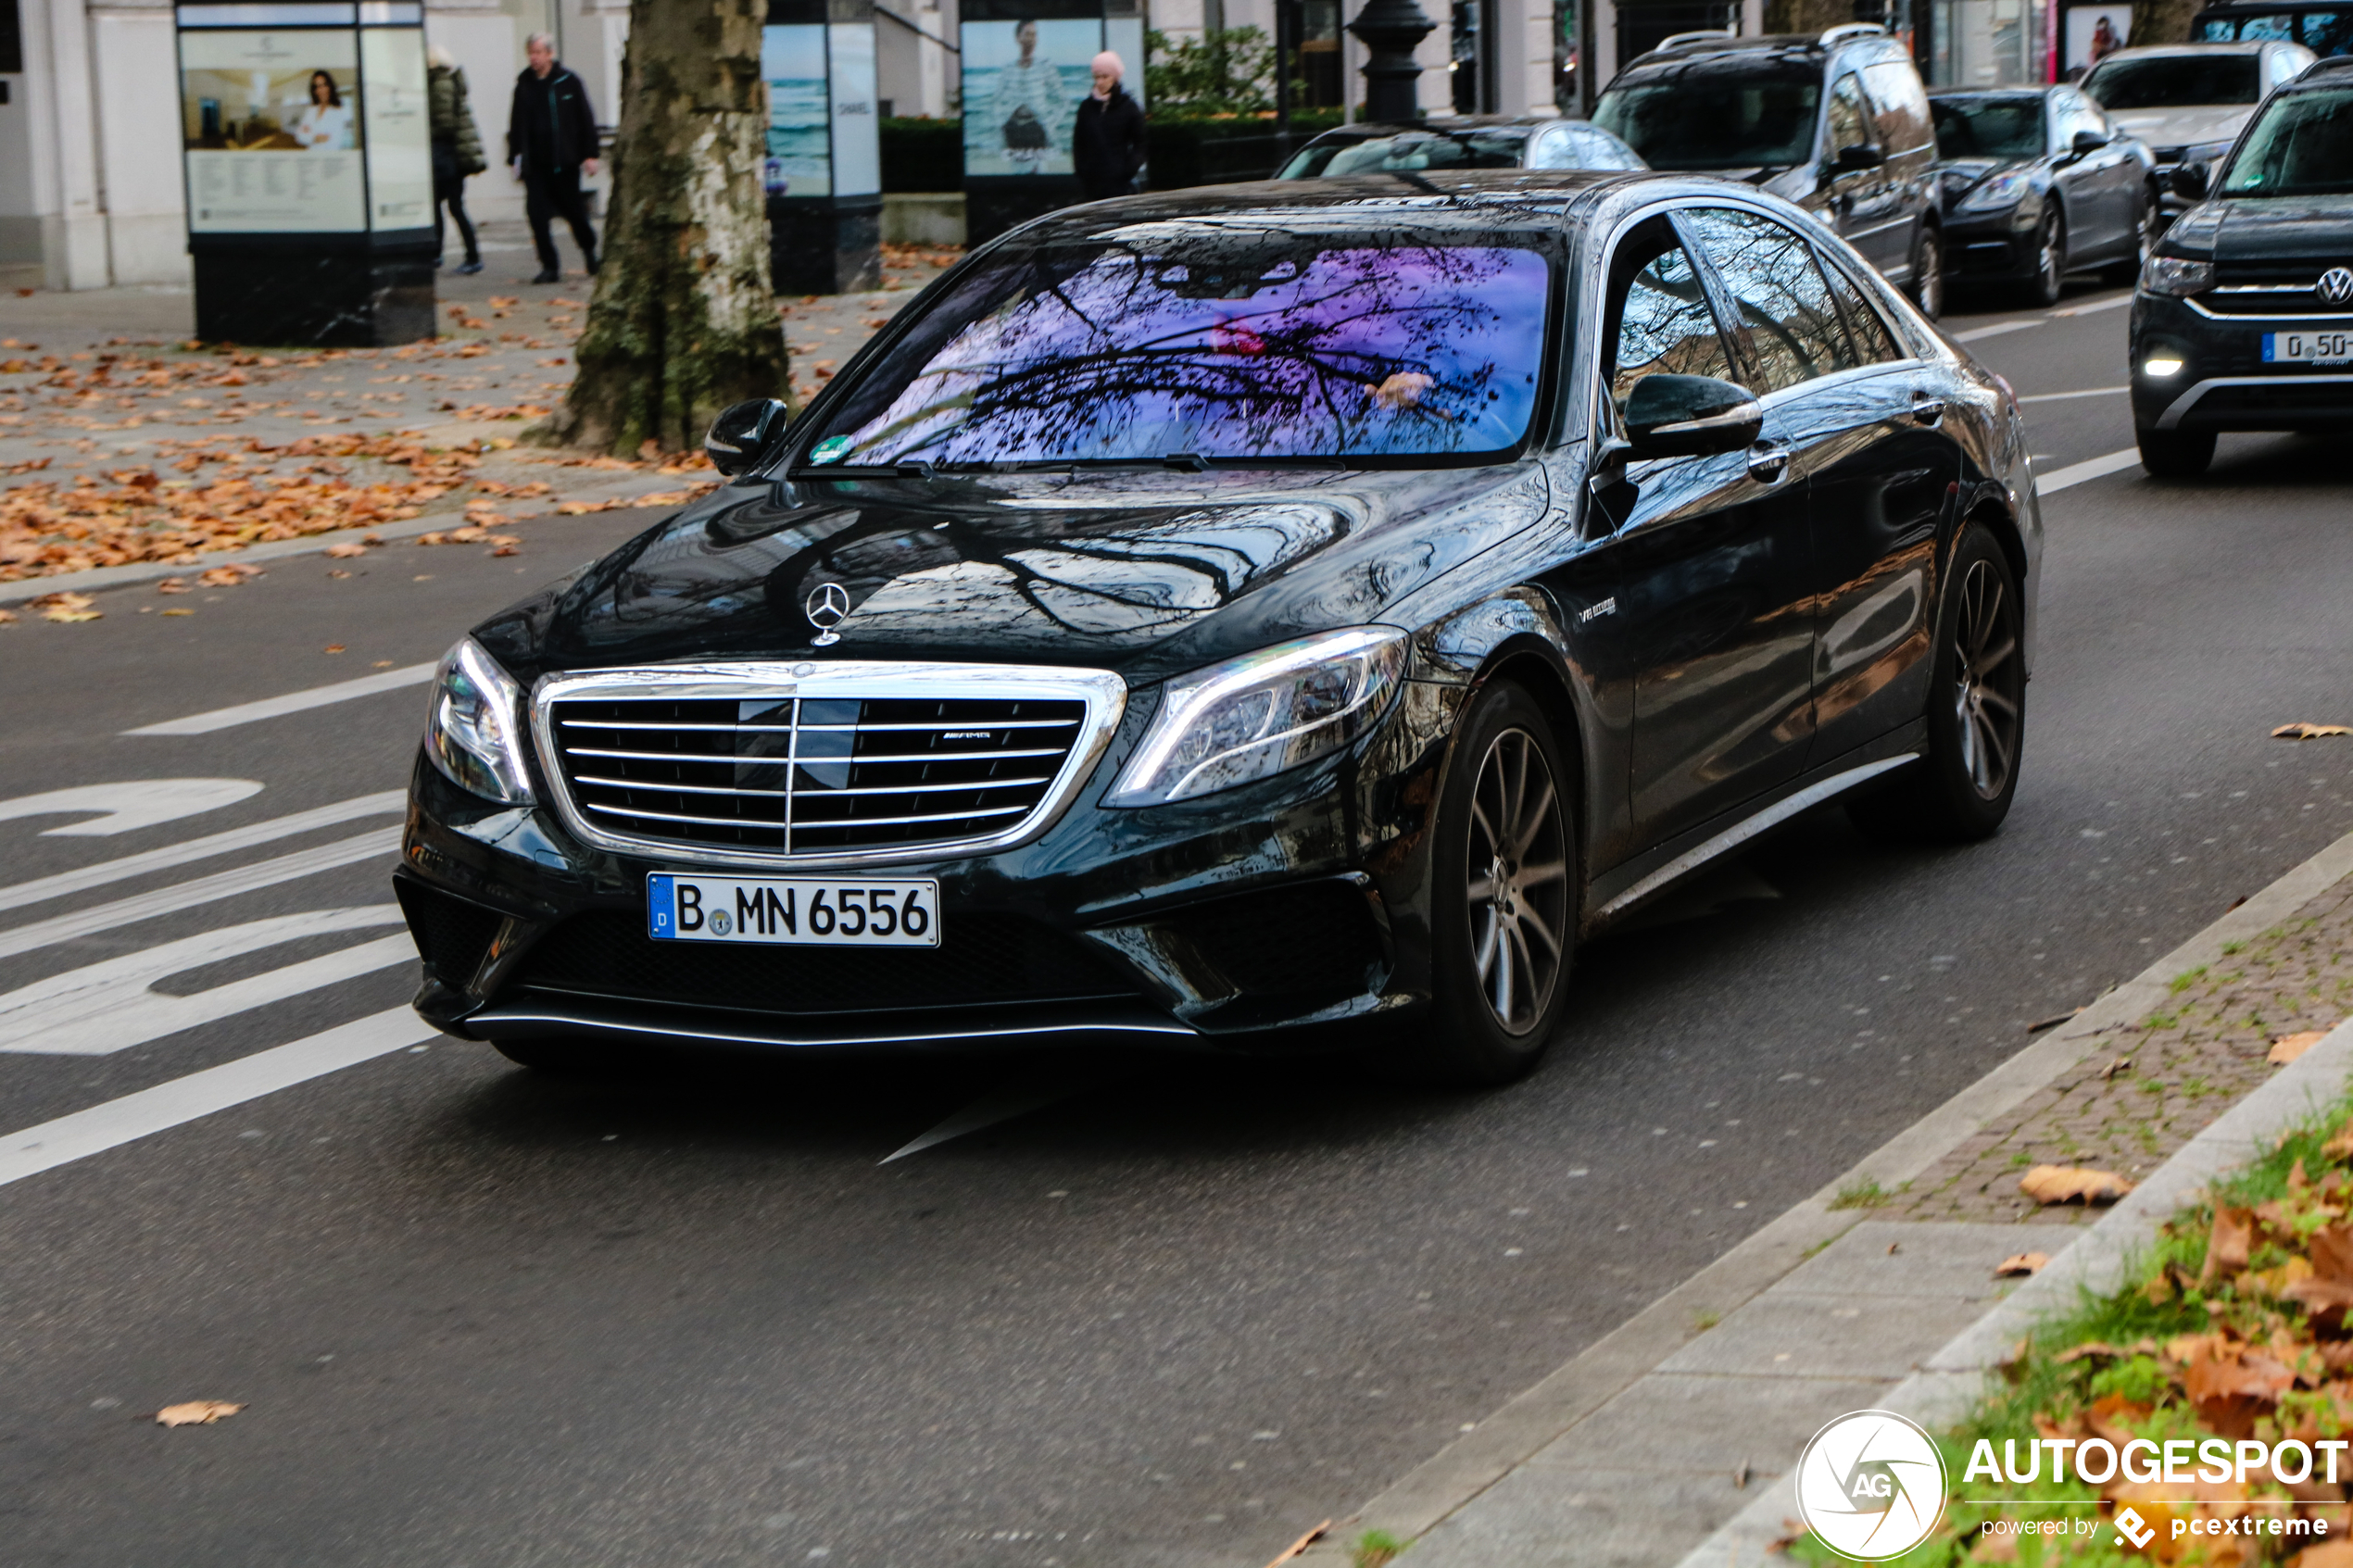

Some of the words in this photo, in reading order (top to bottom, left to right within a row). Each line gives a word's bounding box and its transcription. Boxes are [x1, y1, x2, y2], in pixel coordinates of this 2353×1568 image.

[658, 912, 667, 926] D
[676, 884, 705, 931] B
[736, 886, 797, 935] MN
[809, 889, 928, 936] 6556
